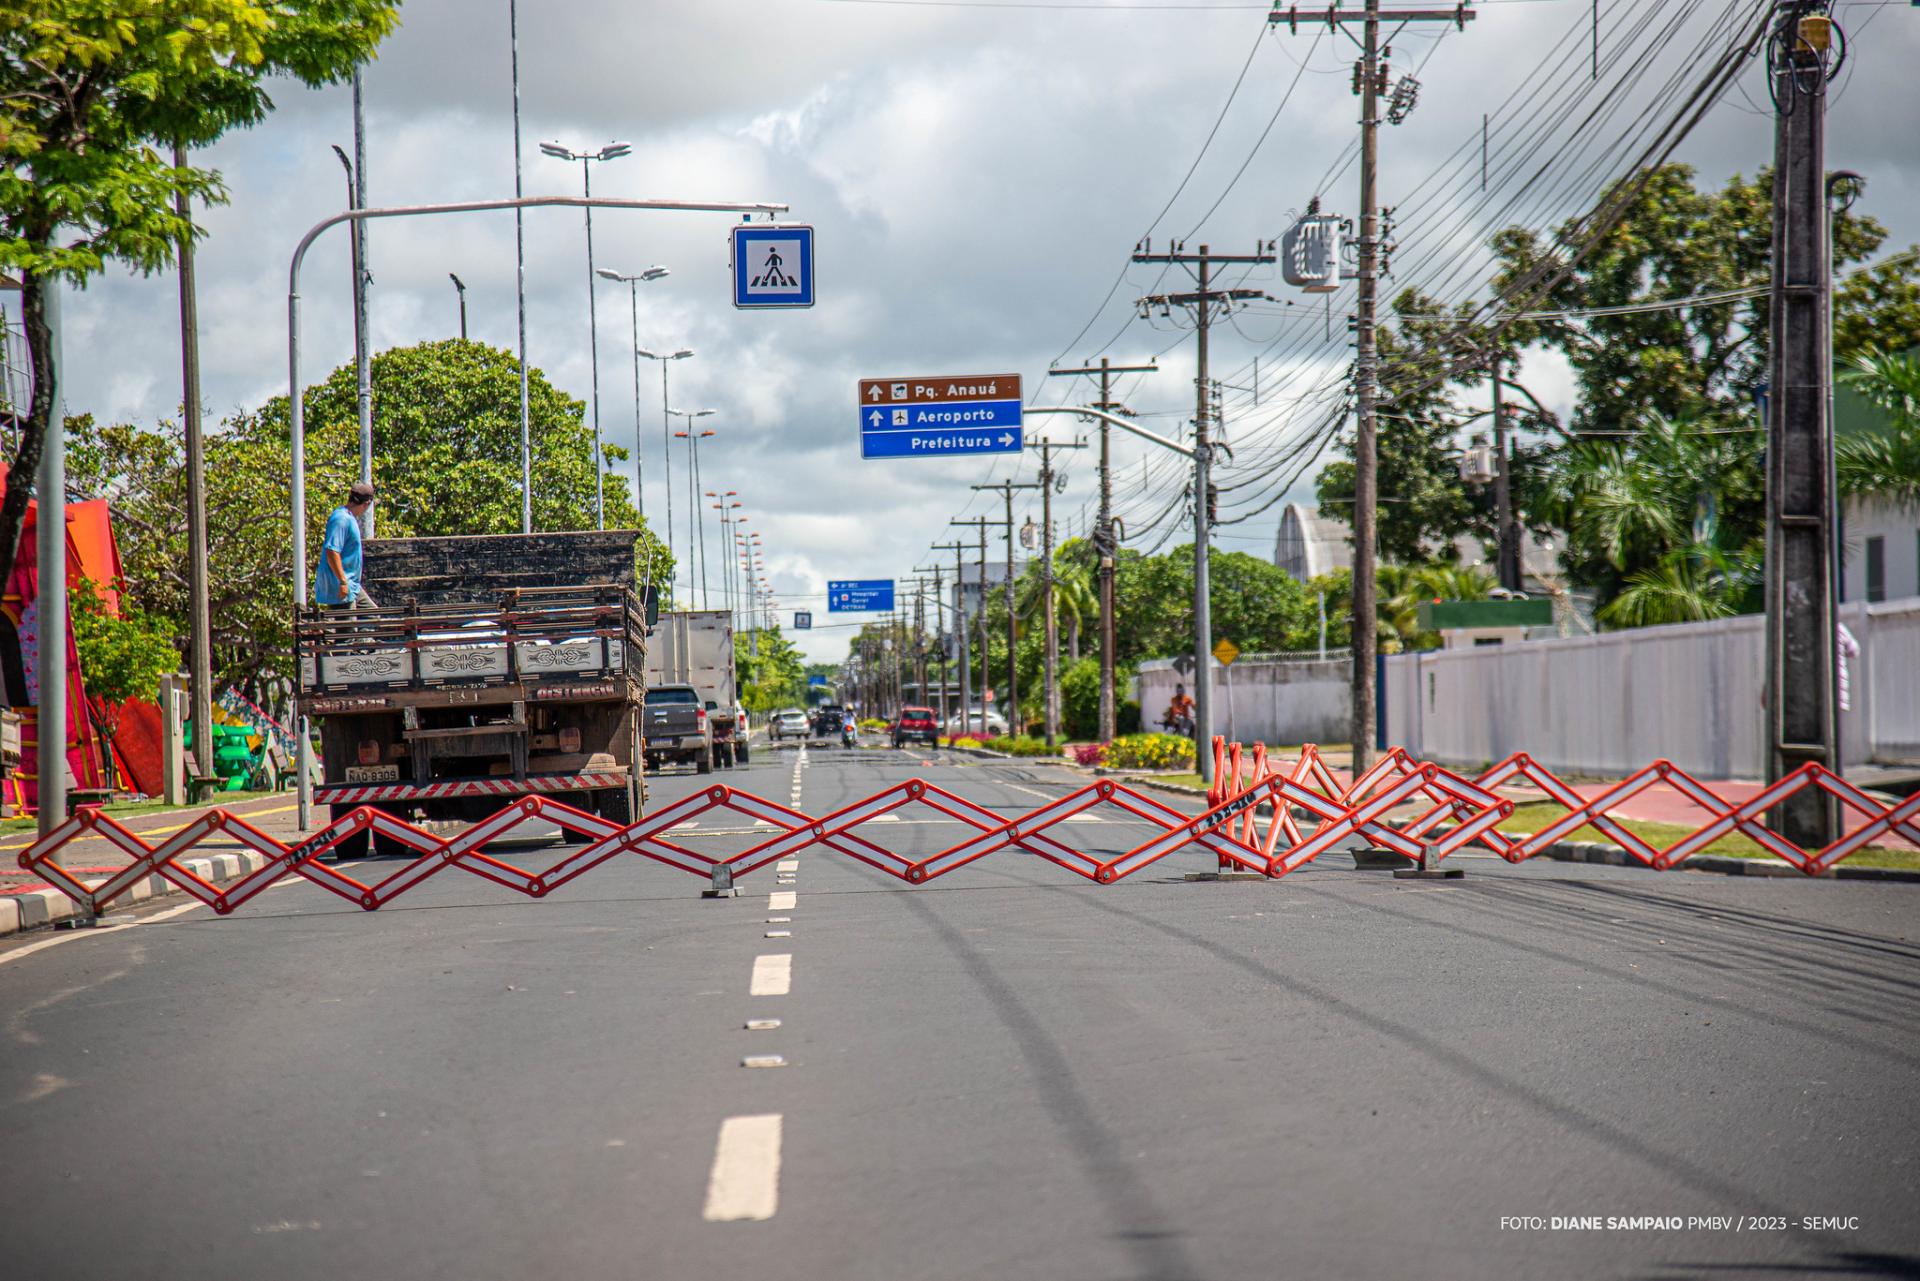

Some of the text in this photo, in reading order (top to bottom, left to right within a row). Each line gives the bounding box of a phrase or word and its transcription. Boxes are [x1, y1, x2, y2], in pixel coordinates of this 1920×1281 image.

[915, 382, 997, 399] Pq. Anauá
[917, 409, 995, 424] Aeroporto
[911, 436, 991, 450] Prefeitura
